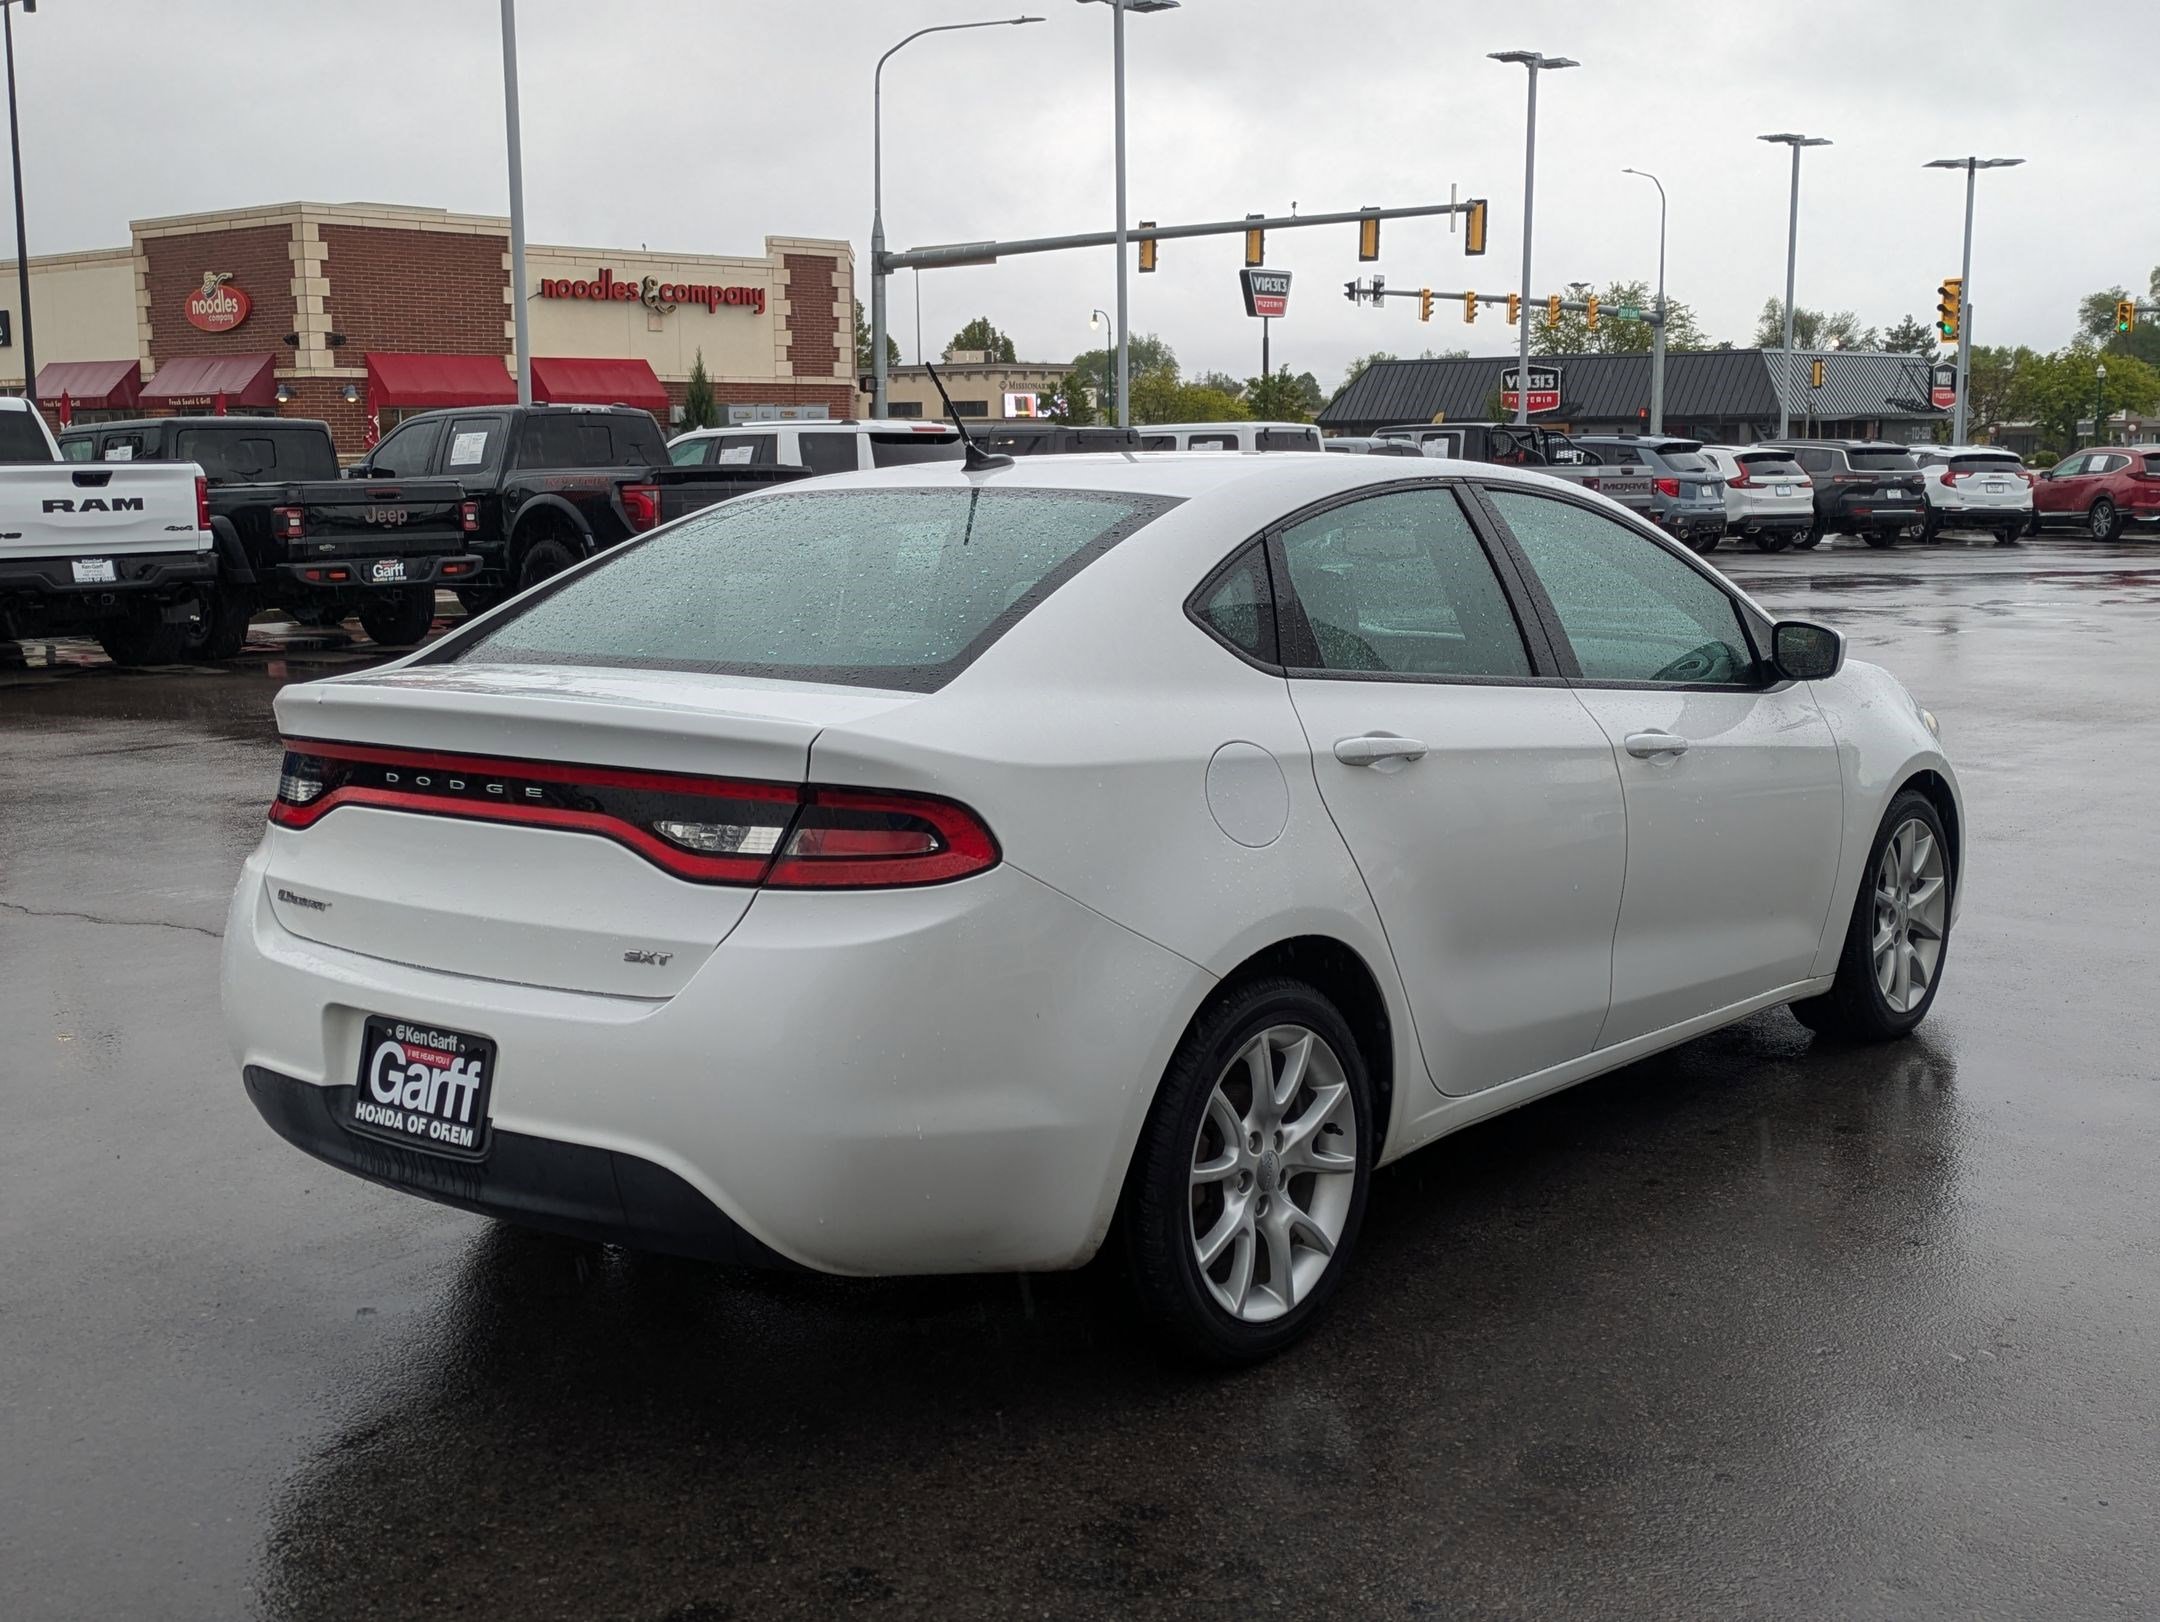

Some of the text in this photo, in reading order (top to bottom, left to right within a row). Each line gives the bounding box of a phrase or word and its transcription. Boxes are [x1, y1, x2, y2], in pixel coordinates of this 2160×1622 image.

[541, 268, 766, 314] noodles & company
[192, 289, 238, 314] noodles
[208, 314, 234, 324] company
[1508, 396, 1552, 404] PIERIA
[42, 498, 144, 513] RAM
[365, 507, 408, 525] Jeep
[373, 562, 404, 577] Garff
[386, 772, 543, 798] DODGE
[624, 949, 673, 966] SXT
[405, 1026, 458, 1052] Ken Garff
[420, 1052, 435, 1062] HEAR
[435, 1056, 446, 1065] YOU
[370, 1041, 481, 1123] Garff
[355, 1102, 473, 1147] HONDA OF OREM
